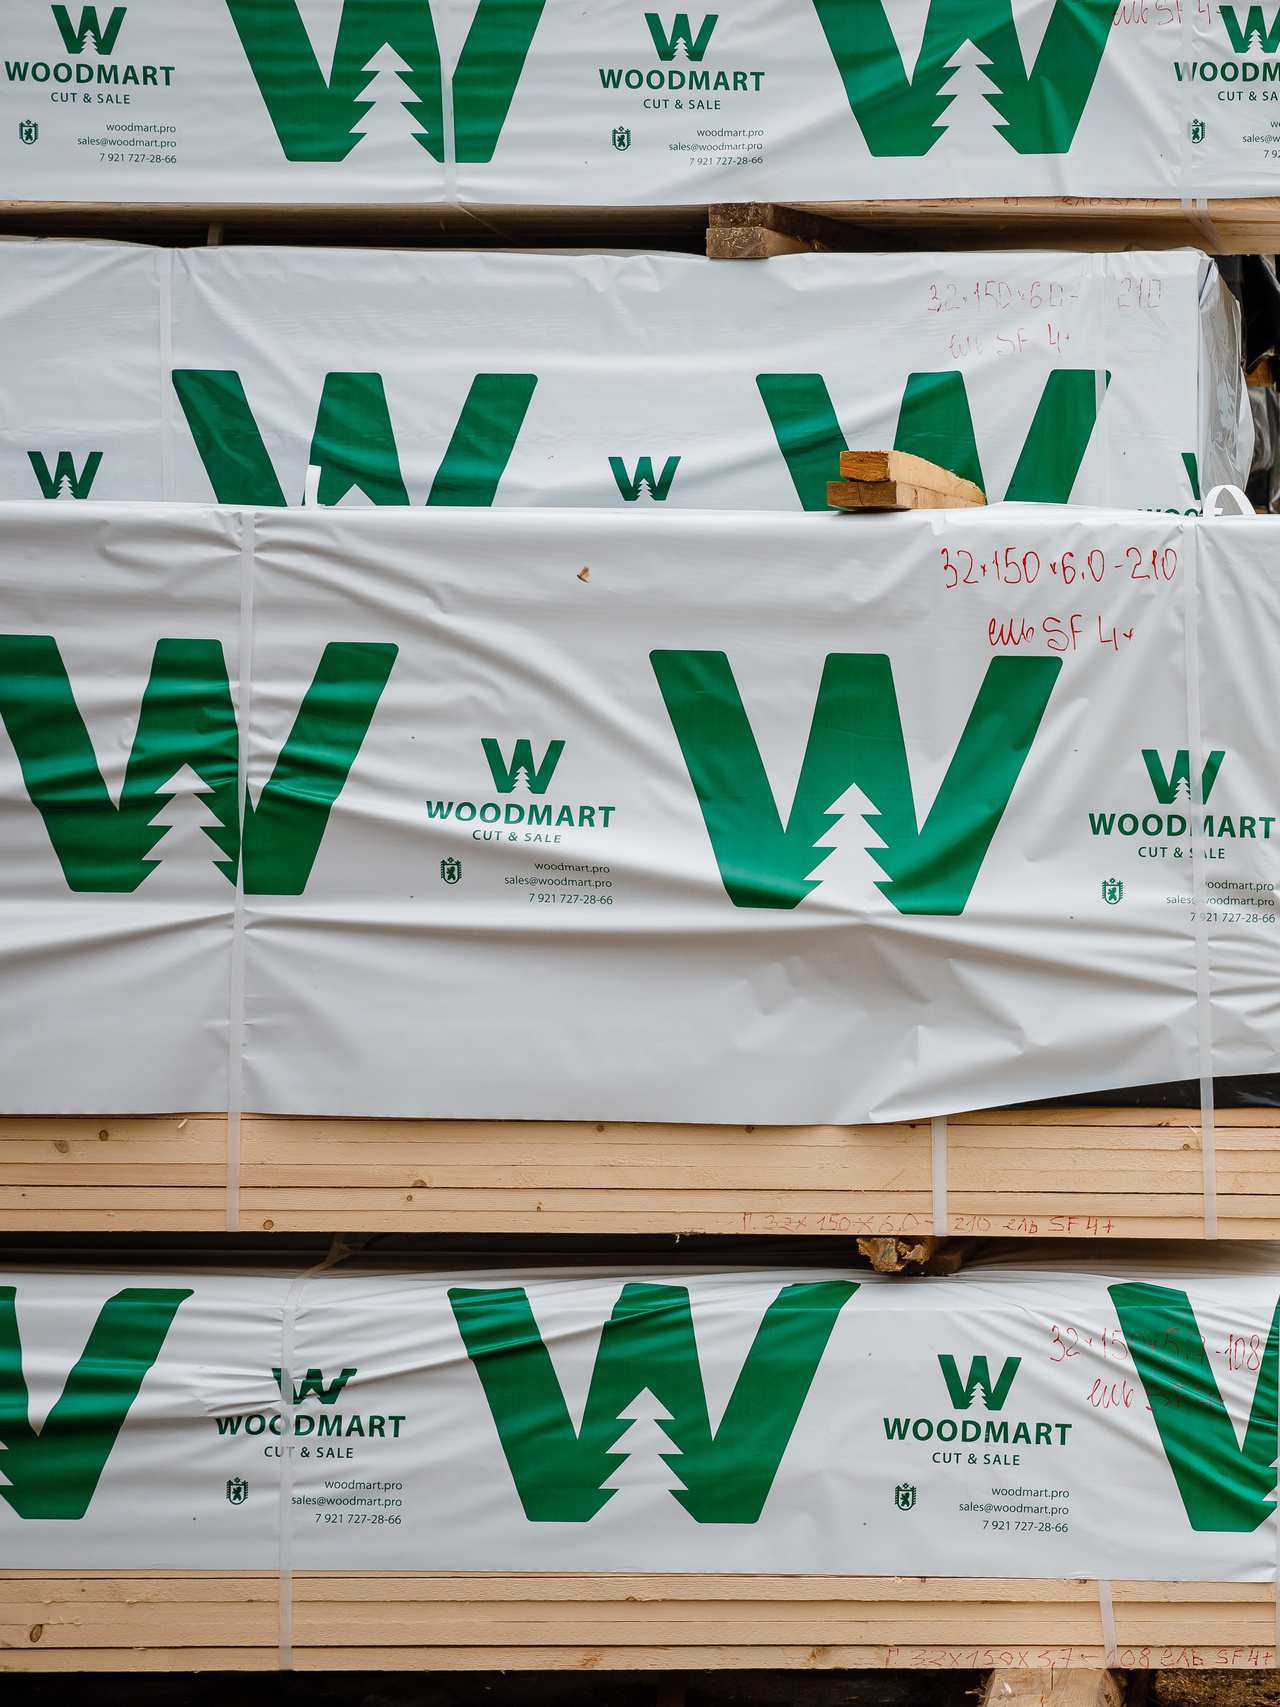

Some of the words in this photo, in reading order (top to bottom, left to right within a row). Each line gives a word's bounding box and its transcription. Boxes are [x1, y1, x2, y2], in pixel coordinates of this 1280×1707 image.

[51, 5, 127, 55] W
[644, 13, 719, 62] W
[5, 61, 175, 86] WOODMART
[599, 69, 765, 92] WOODMART
[811, 0, 1115, 157] W
[225, 0, 547, 163] W
[51, 92, 77, 103] CUT
[83, 93, 92, 103] &
[97, 94, 131, 104] SALE
[1217, 91, 1243, 101] CUT
[1249, 91, 1257, 101] &
[643, 99, 669, 109] CUT
[675, 100, 683, 109] &
[689, 100, 721, 110] SALE
[106, 123, 177, 134] woodmart.pro
[697, 128, 764, 139] woodmart.pro
[78, 137, 177, 149] sales@woodmart.pro
[669, 142, 763, 152] sales@woodmart.pro
[100, 153, 105, 162] 7
[108, 153, 125, 163] 921
[128, 154, 177, 164] 727-28-66
[689, 158, 695, 166] 7
[697, 158, 713, 166] 921
[716, 156, 763, 166] 727-28-66
[1264, 150, 1269, 158] 7
[1117, 277, 1161, 308] 210
[997, 327, 1028, 356] SF
[27, 452, 103, 499] W
[609, 457, 681, 501] W
[1043, 614, 1083, 651] SF
[0, 634, 399, 895] W
[481, 738, 566, 794] W
[649, 649, 1063, 917] W
[1141, 749, 1226, 805] W
[426, 801, 616, 828] WOODMART
[472, 830, 503, 841] CUT
[508, 832, 518, 842] &
[524, 833, 562, 844] SALE
[1138, 847, 1168, 858] CUT
[1173, 847, 1183, 858] &
[534, 862, 610, 874] woodmart.pro
[504, 875, 613, 889] sales@woodmart.pro
[1205, 880, 1274, 892] oodmart.pro
[529, 893, 535, 903] 7
[538, 894, 556, 904] 921
[560, 894, 613, 905] 727-28-66
[1190, 912, 1196, 922] 7
[1200, 912, 1218, 922] 921
[1222, 913, 1276, 923] 727-28-66
[1048, 1216, 1079, 1233] SF
[938, 1354, 1022, 1411] W
[447, 1280, 861, 1523] W
[215, 1415, 406, 1437] WOODMART
[883, 1418, 1072, 1445] WOODMART
[264, 1446, 294, 1458] CUT
[300, 1447, 310, 1458] &
[317, 1447, 353, 1458] SALE
[932, 1453, 962, 1464] CUT
[968, 1453, 977, 1464] &
[984, 1454, 1020, 1465] SALE
[325, 1480, 403, 1491] woodmart.pro
[992, 1487, 1069, 1498] woodmart.pro
[292, 1496, 402, 1508] sales@woodmart.pro
[959, 1502, 1069, 1515] sales@woodmart.pro
[315, 1513, 322, 1523] 7
[325, 1514, 343, 1523] 921
[348, 1514, 401, 1524] 727-28-66
[983, 1520, 989, 1530] 7
[992, 1521, 1010, 1531] 921
[1014, 1521, 1068, 1532] 727-28-66
[1216, 1649, 1244, 1664] SF
